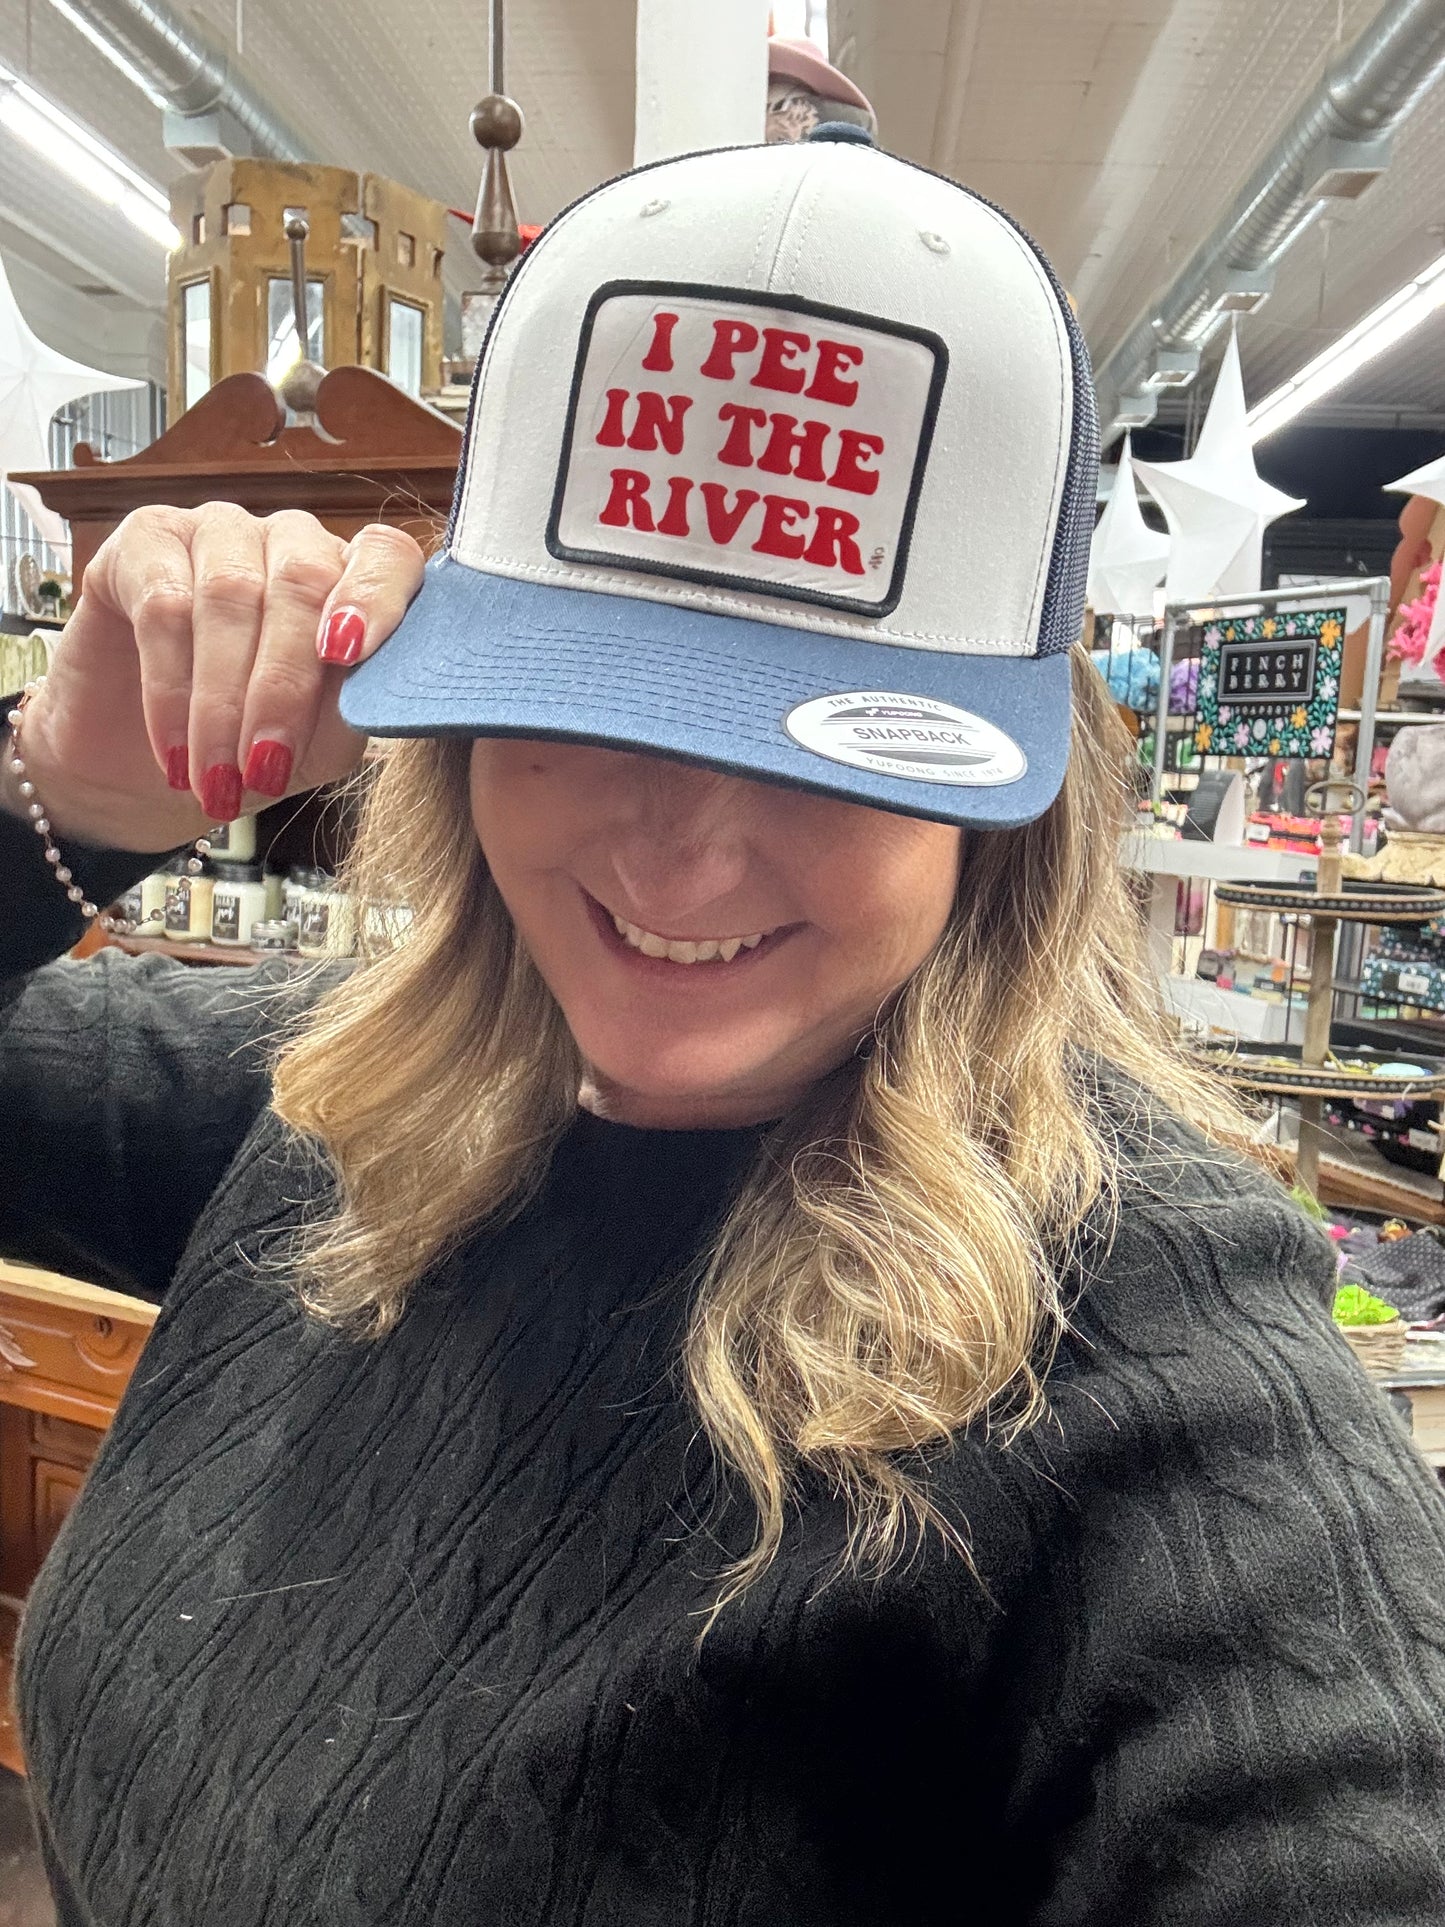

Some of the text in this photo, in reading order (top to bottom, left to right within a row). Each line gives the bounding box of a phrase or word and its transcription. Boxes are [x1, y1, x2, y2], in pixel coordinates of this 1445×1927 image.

[642, 312, 864, 408] I PEE
[595, 388, 885, 496] IN THE
[599, 468, 866, 576] RIVER
[1231, 654, 1304, 672] FINCH
[1229, 672, 1301, 689] BERRY
[827, 695, 942, 711] THE AUTHENTIC
[881, 709, 923, 718] YUPOONG
[852, 727, 971, 746] SNAPBACK
[865, 757, 936, 776] YUPOONG
[943, 770, 976, 779] SINCE
